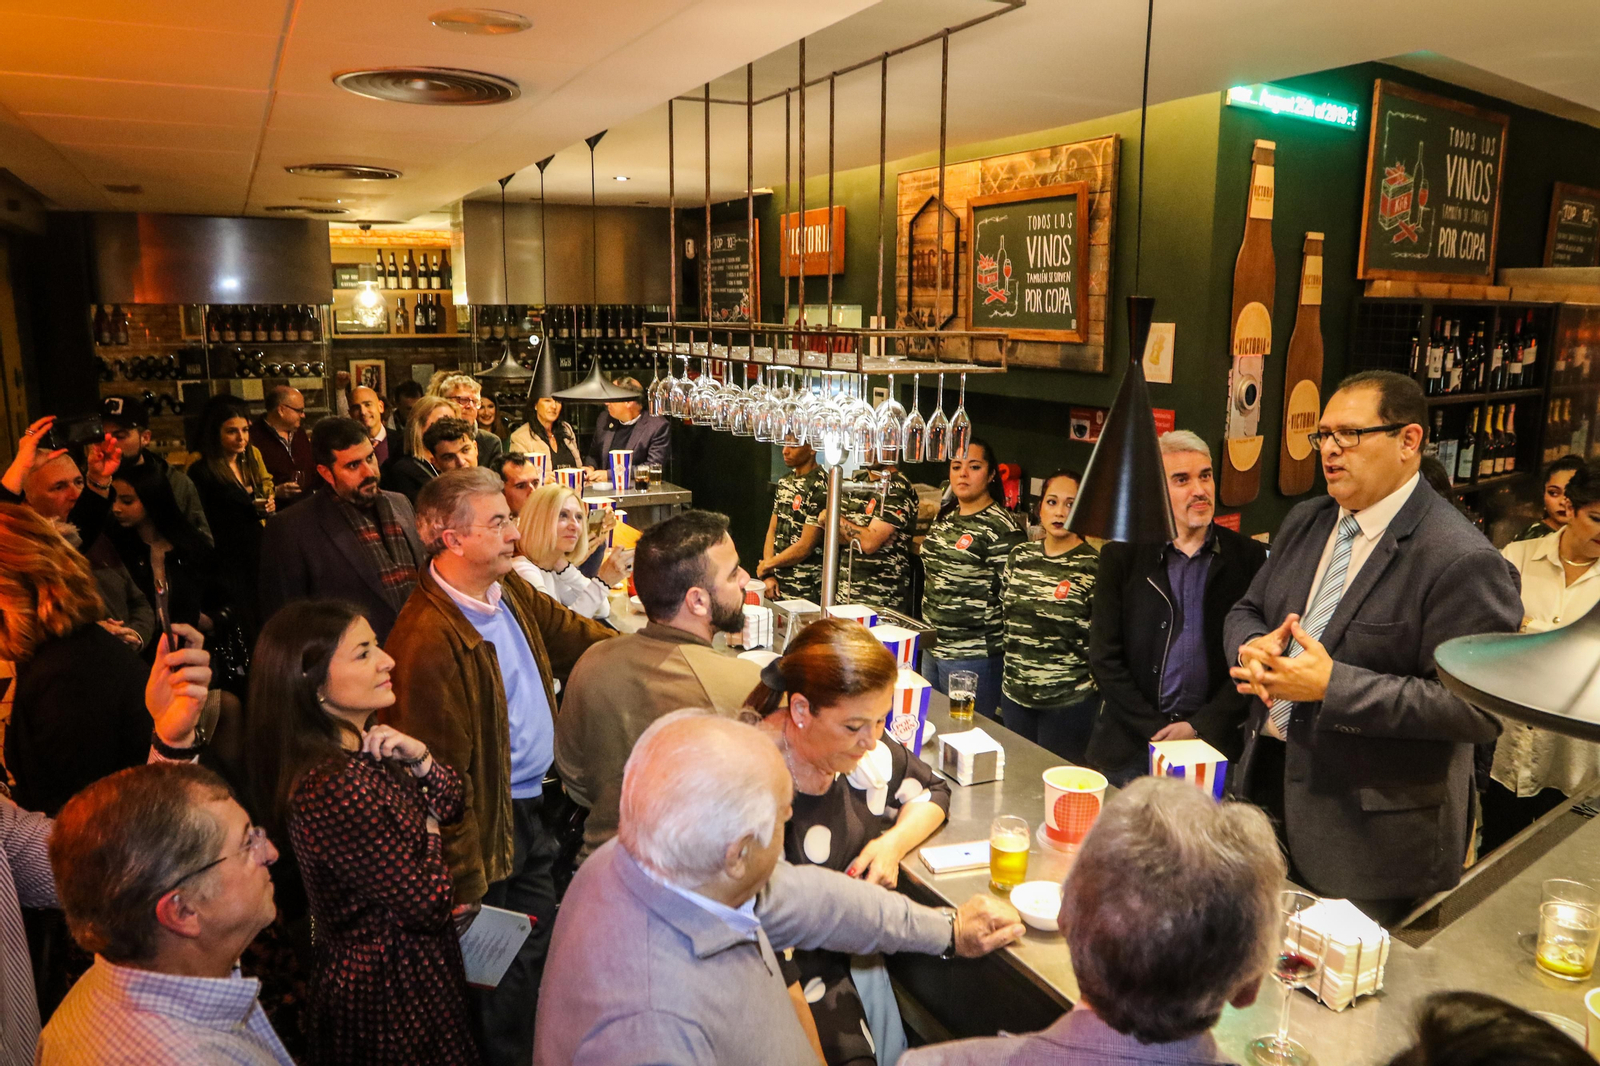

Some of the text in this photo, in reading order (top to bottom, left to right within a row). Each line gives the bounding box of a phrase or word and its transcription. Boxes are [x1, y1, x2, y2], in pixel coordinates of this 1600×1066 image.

[1449, 126, 1496, 156] TODOS LOS
[1446, 154, 1493, 204] VINOS
[1562, 204, 1577, 219] TOP
[1028, 212, 1073, 231] TODOS LOS
[714, 237, 723, 249] TOP
[1026, 233, 1072, 268] VINOS
[1438, 227, 1487, 261] POR COPA
[1026, 269, 1048, 283] TAMBIÉN
[1025, 287, 1072, 314] POR COPA
[1238, 337, 1267, 355] VICTORIA
[1290, 411, 1316, 430] VICTORIA
[895, 719, 911, 731] POP
